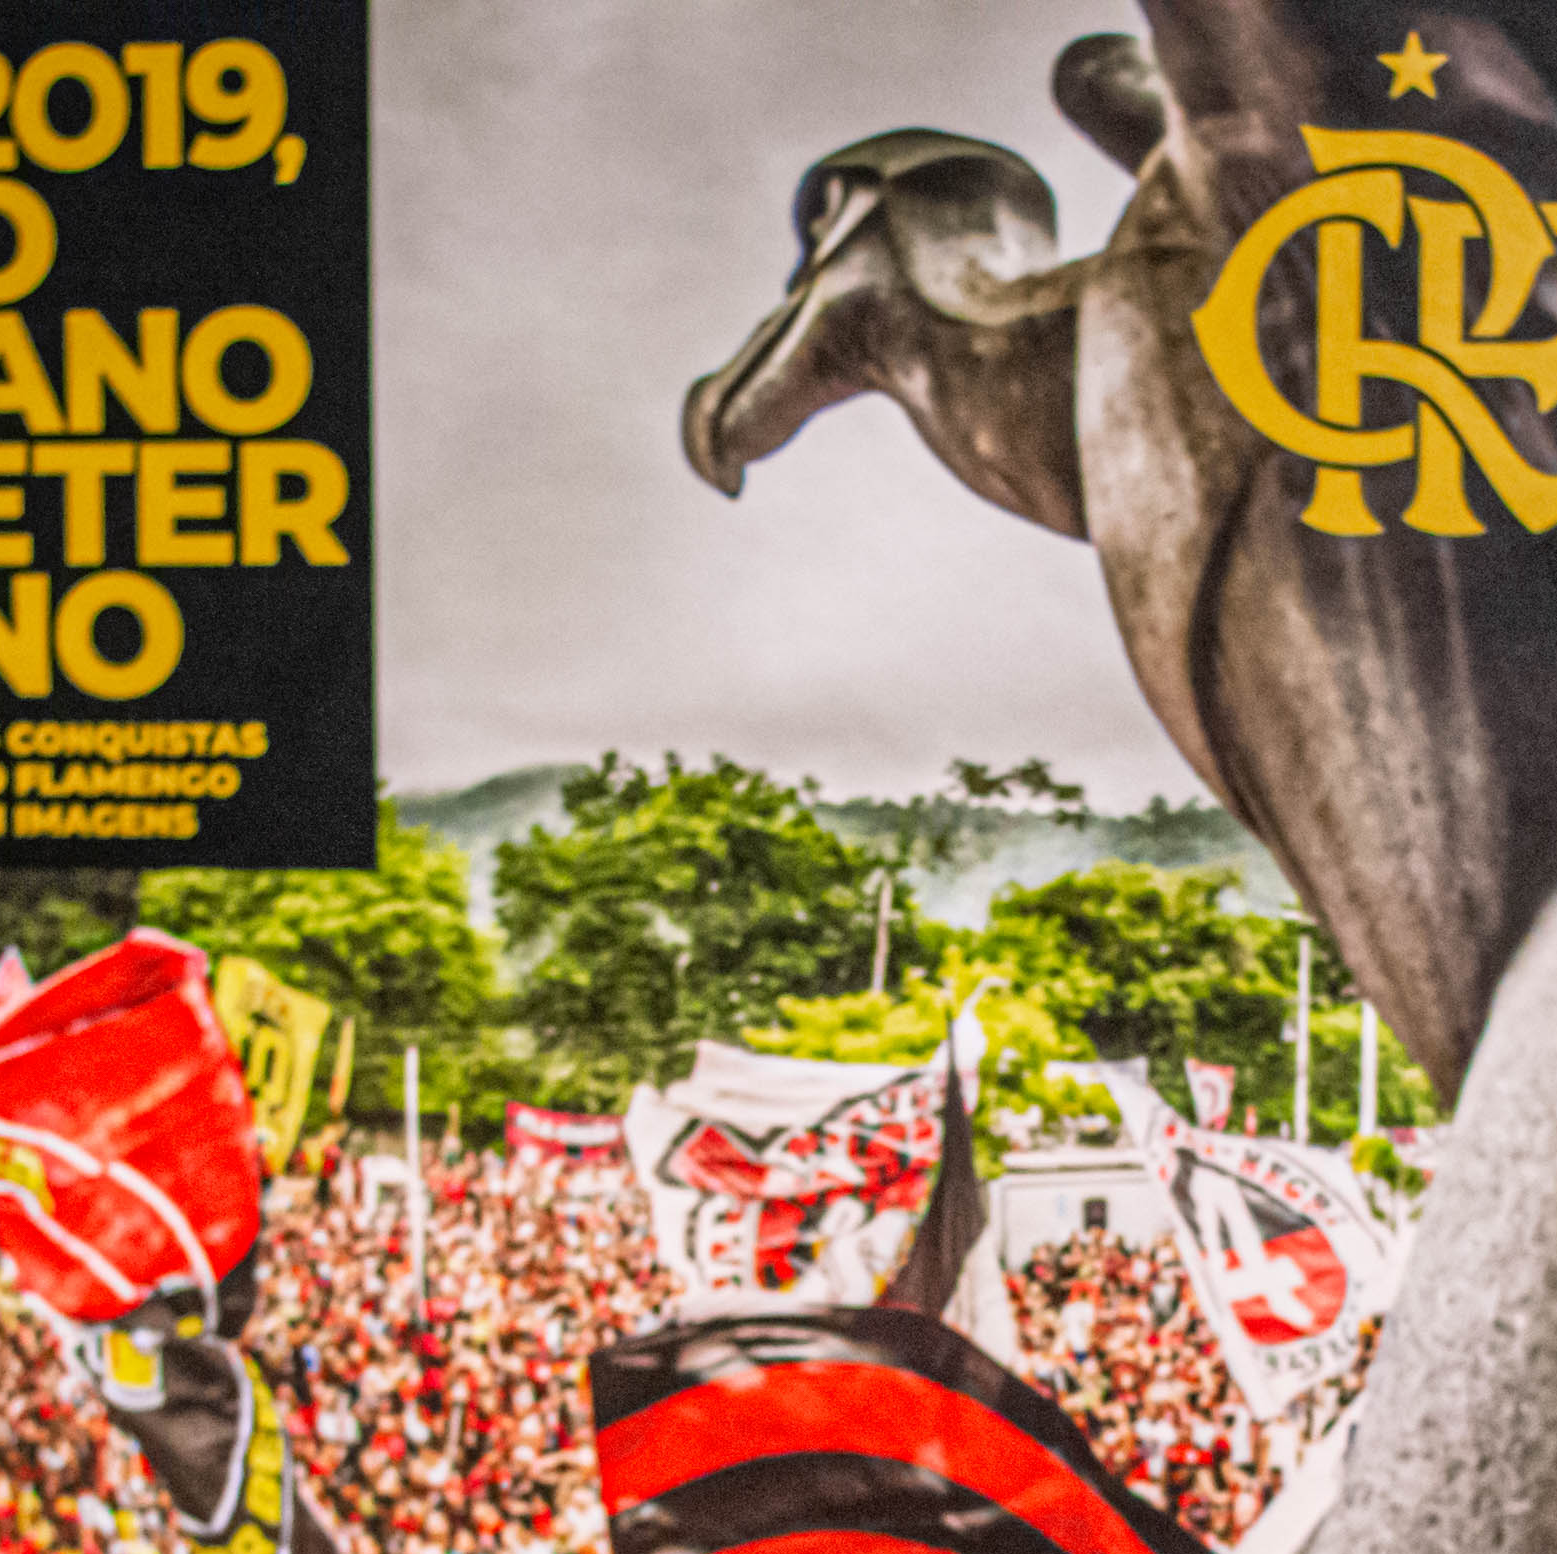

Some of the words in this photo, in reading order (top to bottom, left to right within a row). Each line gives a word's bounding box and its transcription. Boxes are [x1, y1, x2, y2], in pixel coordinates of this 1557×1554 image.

[6, 721, 269, 763] CONQUISTAS
[14, 762, 241, 798] FLAMENGO
[13, 803, 199, 838] IMAGENS
